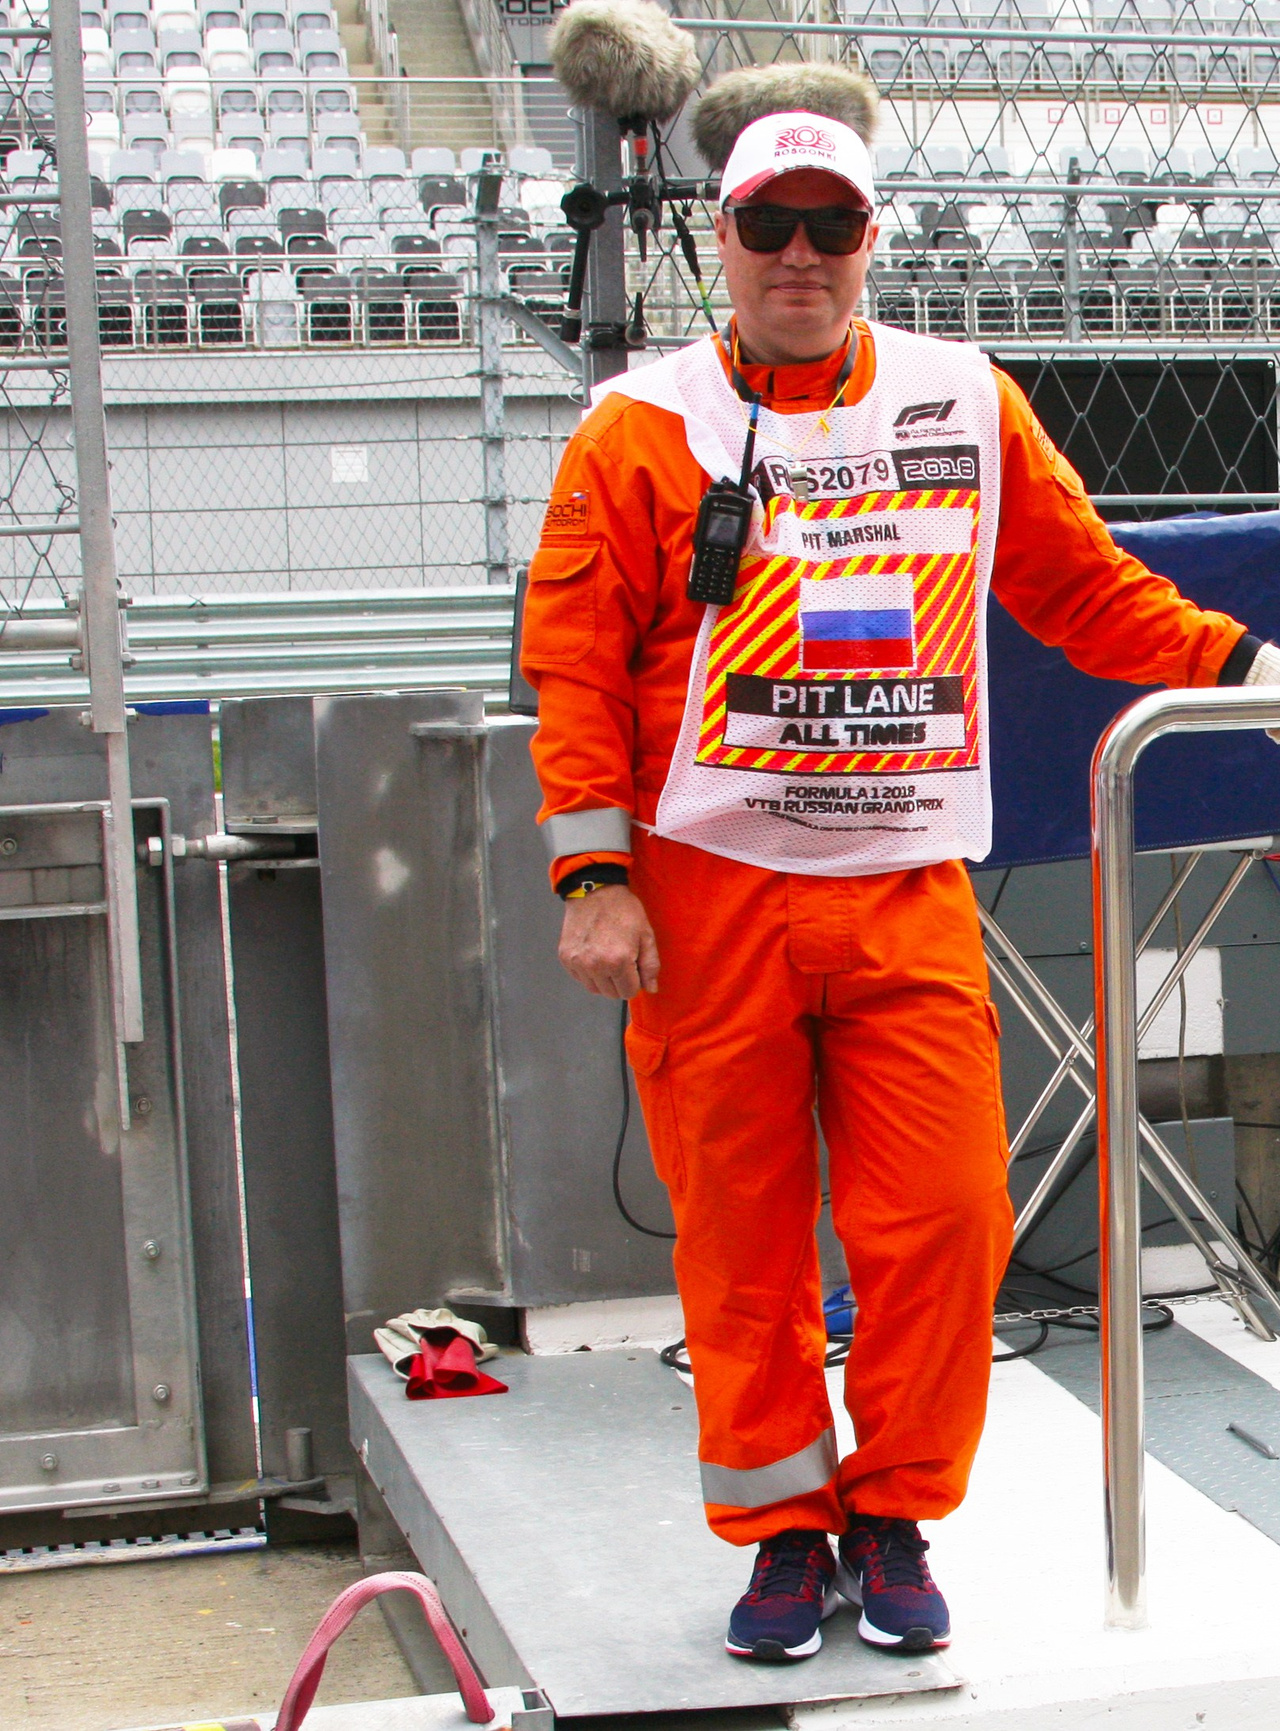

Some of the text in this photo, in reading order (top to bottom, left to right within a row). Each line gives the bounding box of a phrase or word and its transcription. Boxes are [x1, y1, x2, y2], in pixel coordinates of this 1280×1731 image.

[775, 126, 836, 152] ROS
[774, 147, 837, 162] ROSGONKI
[901, 456, 975, 482] 2018
[545, 503, 587, 518] SOCHI
[801, 522, 901, 550] PIT MARSHAL
[772, 683, 935, 714] PIT LANE
[779, 721, 927, 746] ALL TIMES
[785, 785, 916, 799] FORMULA 1 2018
[745, 797, 944, 814] VTB RUSSIAN GRAND PRIX
